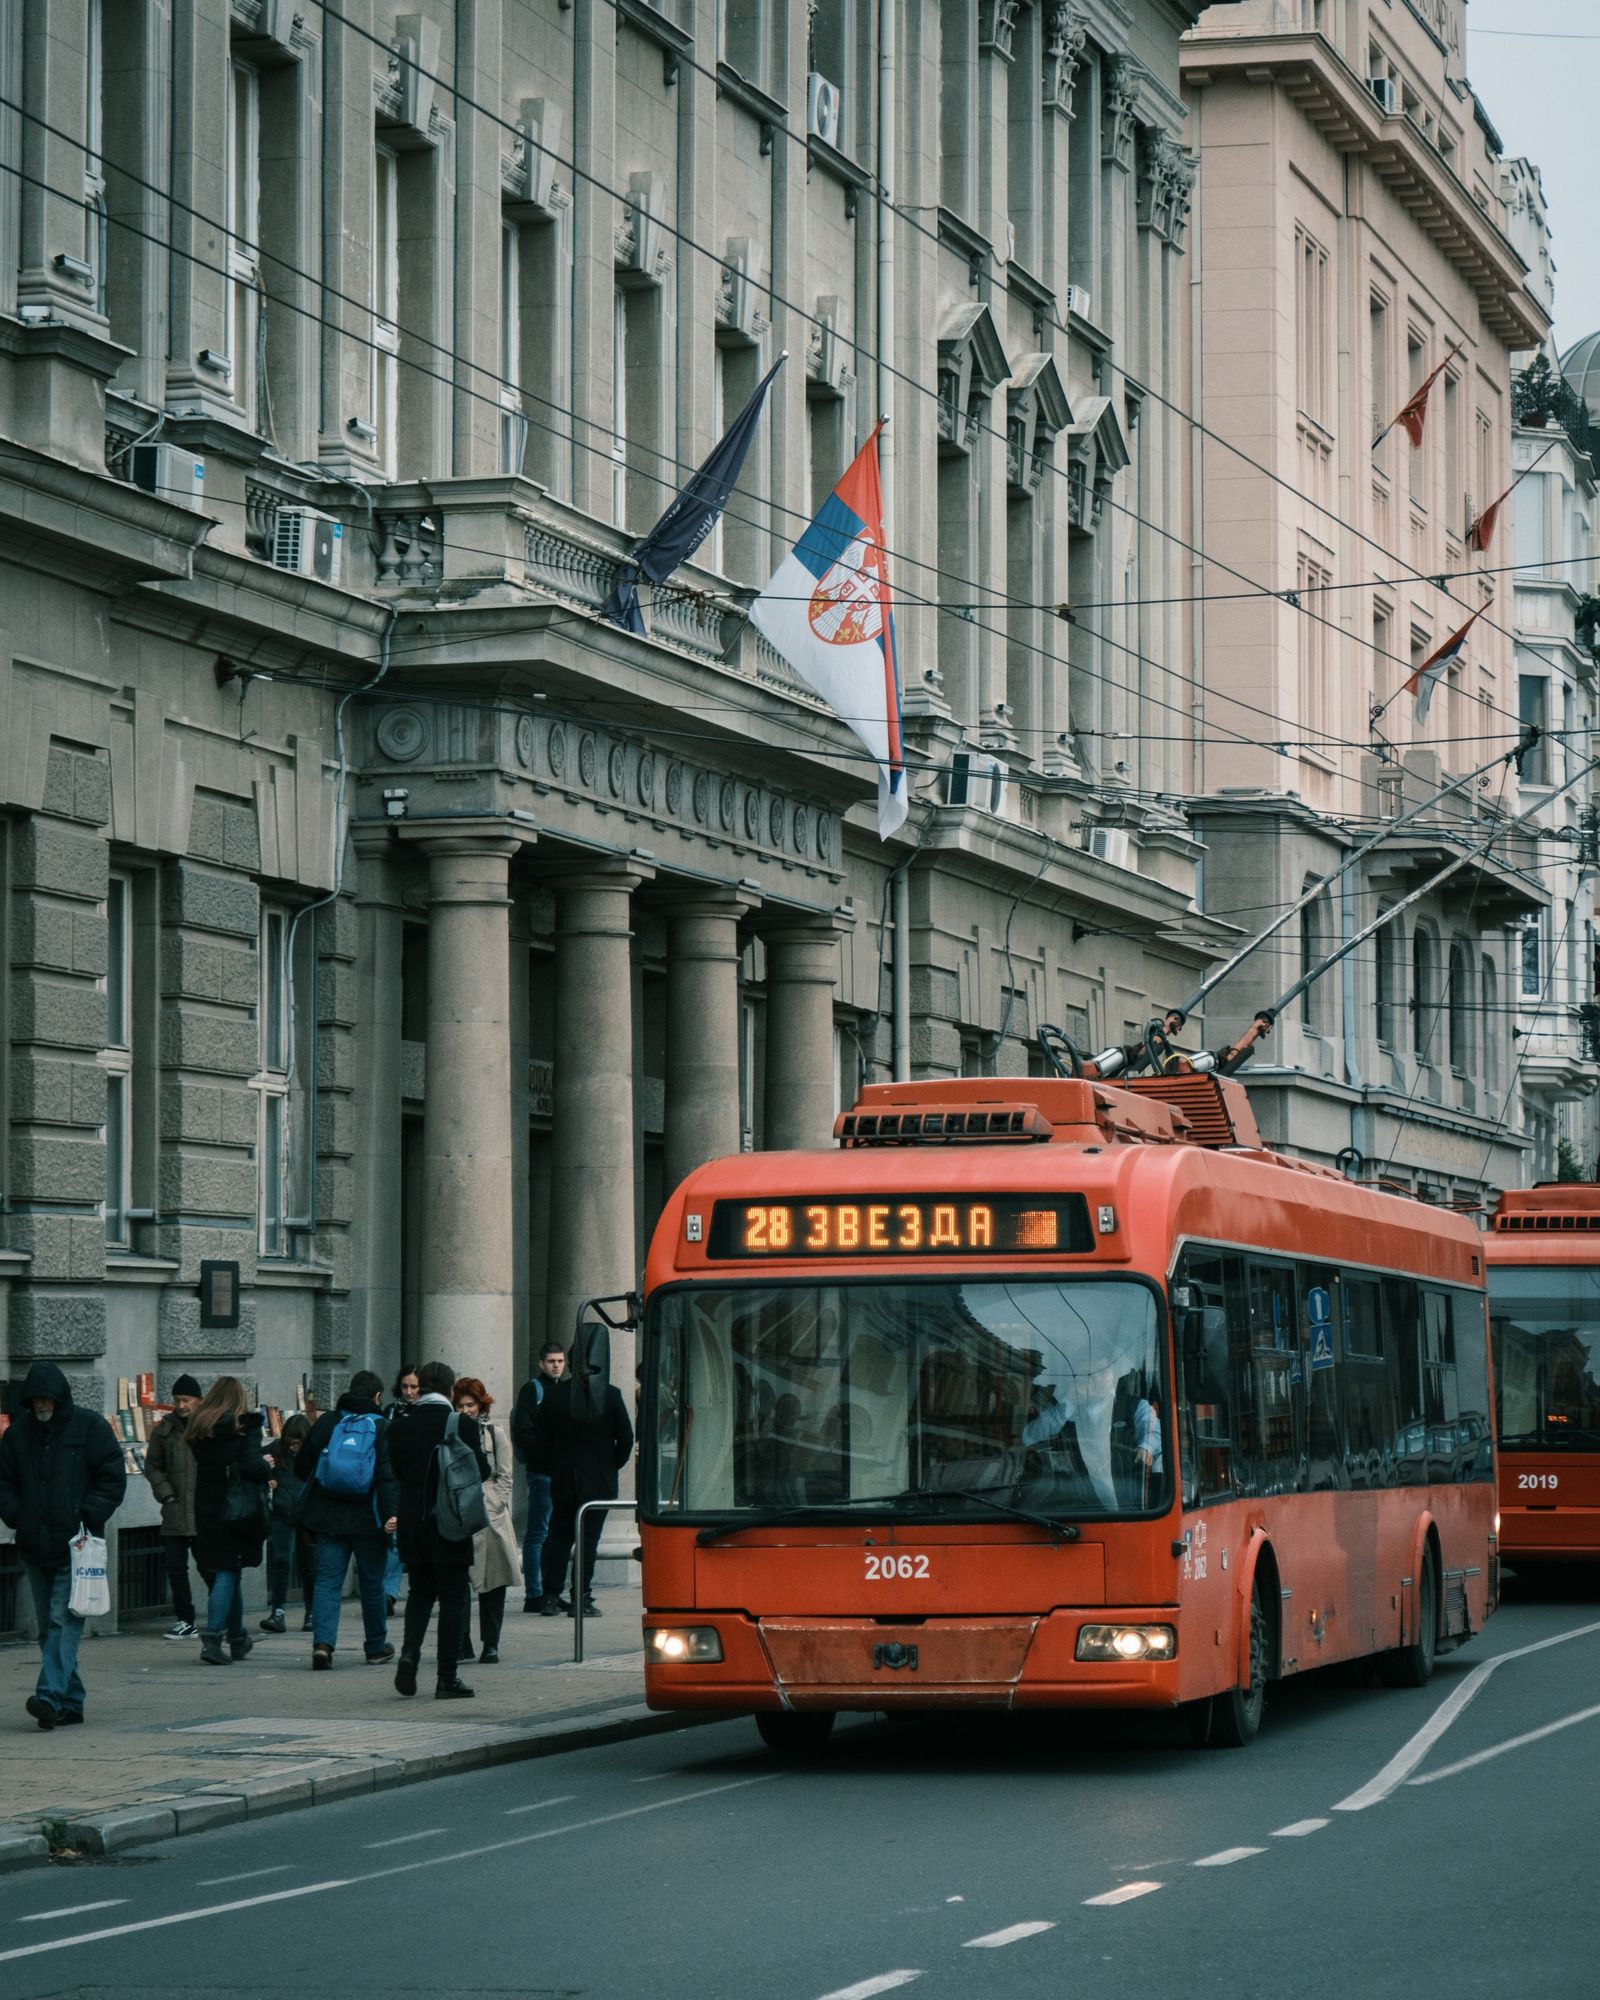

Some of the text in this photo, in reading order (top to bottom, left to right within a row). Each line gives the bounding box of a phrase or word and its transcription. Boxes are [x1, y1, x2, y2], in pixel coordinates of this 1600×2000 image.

[747, 1207, 991, 1247] 28 ЗВЕЗДА
[1518, 1474, 1558, 1489] 2019
[864, 1554, 931, 1580] 2062
[1195, 1556, 1207, 1580] 2062
